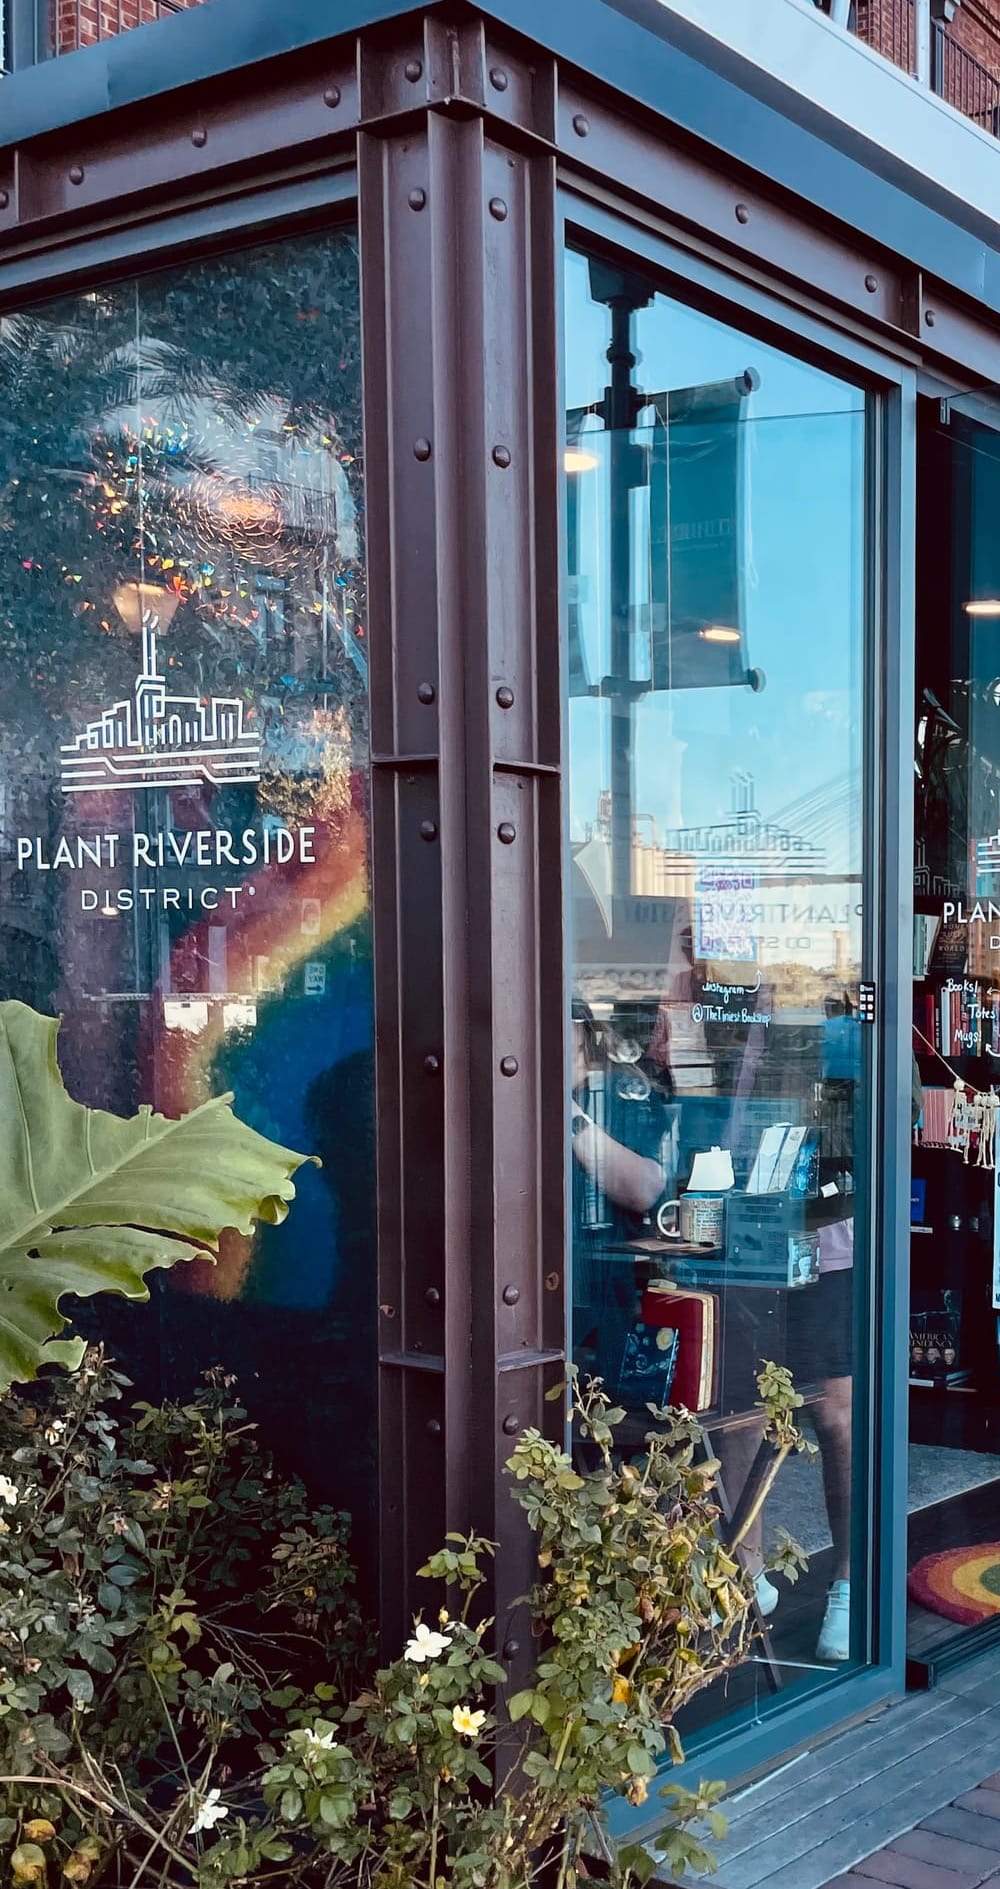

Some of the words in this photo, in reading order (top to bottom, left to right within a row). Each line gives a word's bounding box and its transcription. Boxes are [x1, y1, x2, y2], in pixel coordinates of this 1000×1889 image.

[17, 834, 119, 870] PLANT
[134, 827, 316, 868] RIVERSIDE
[946, 978, 978, 997] Books!
[954, 1028, 982, 1048] Mugs!
